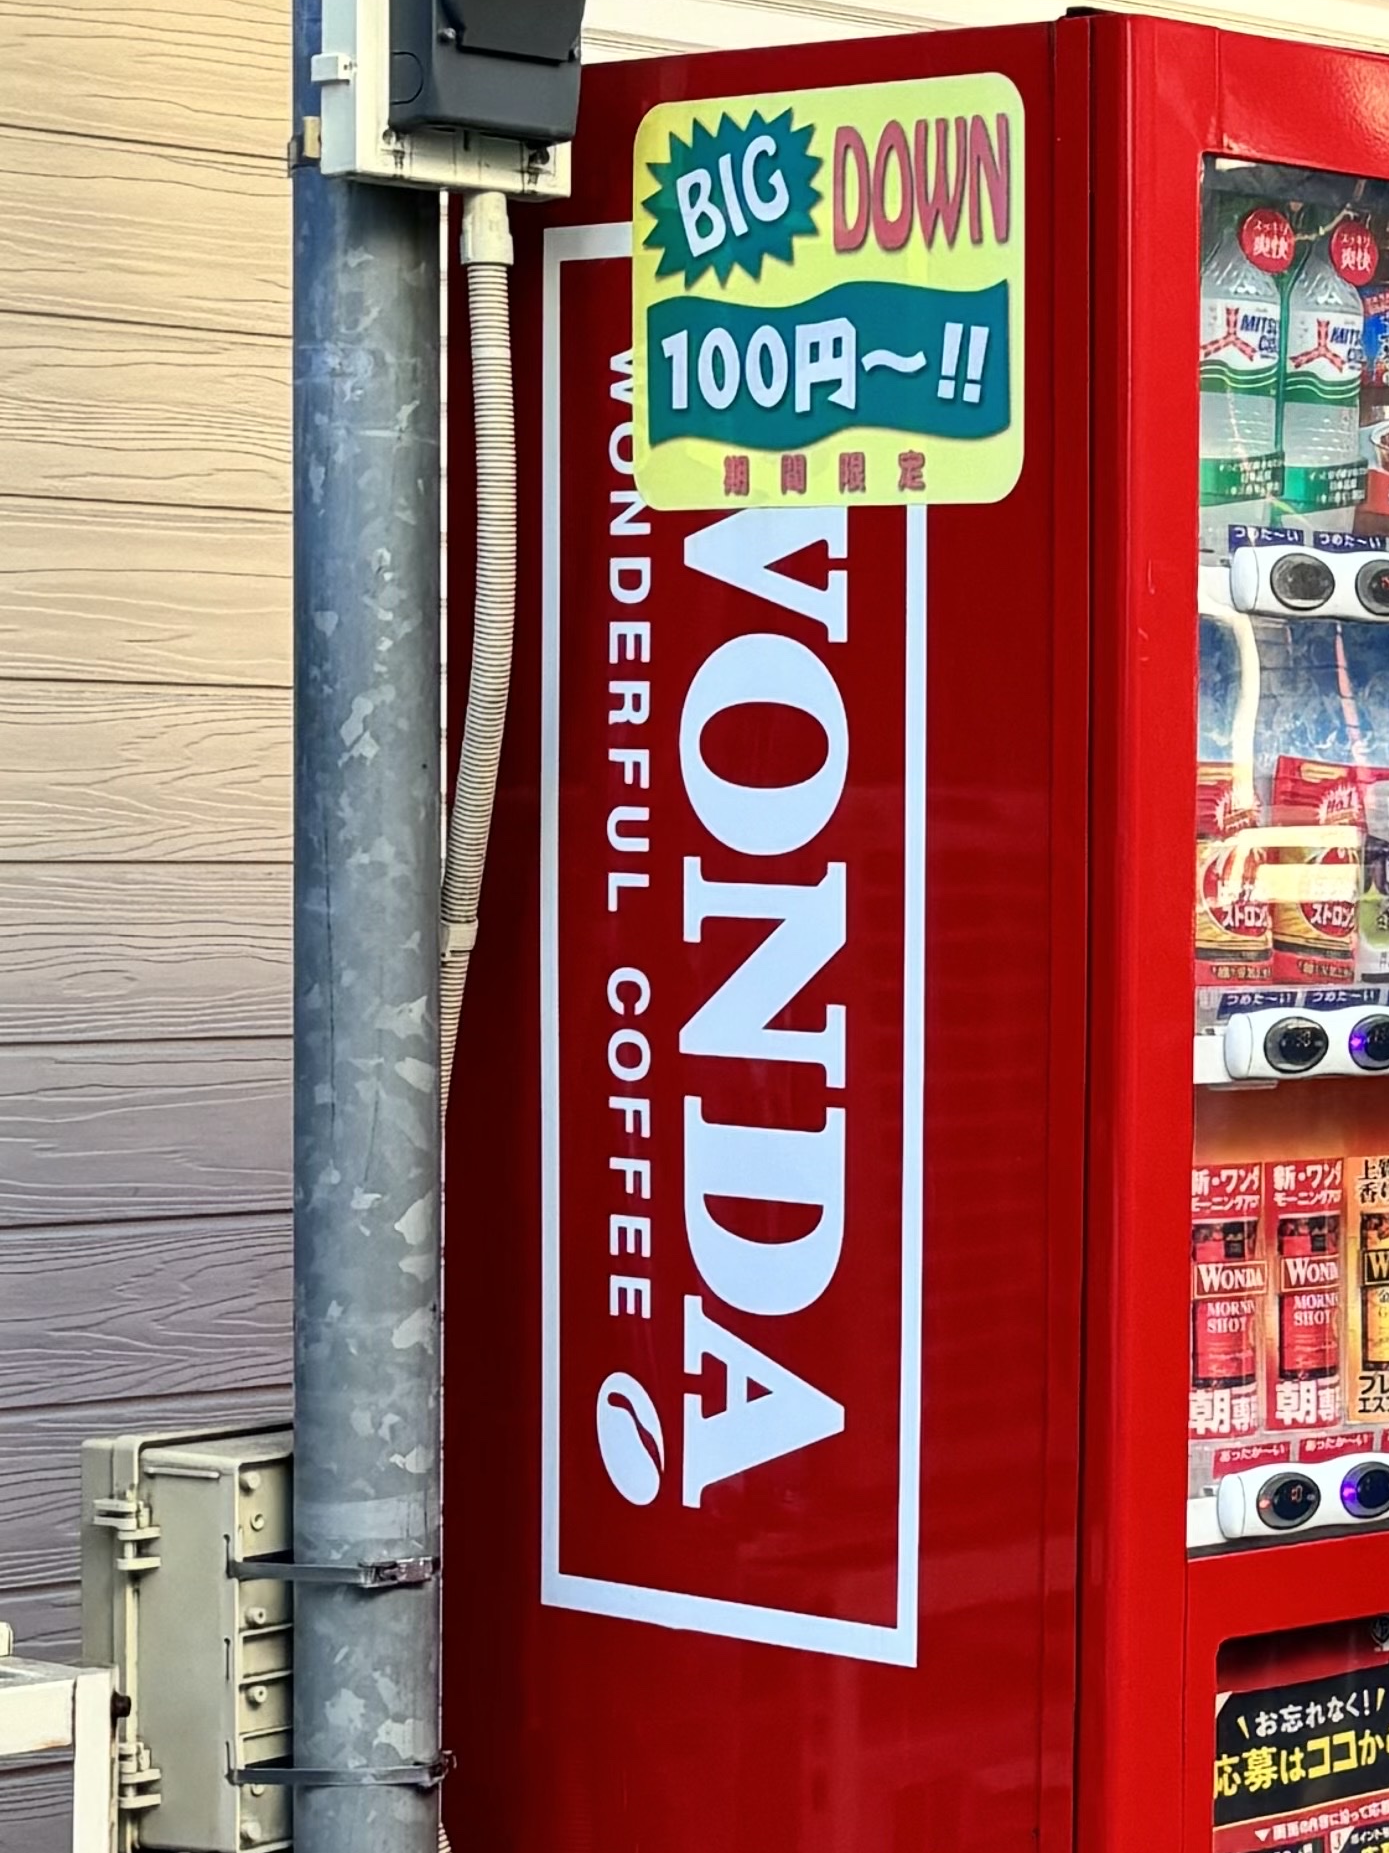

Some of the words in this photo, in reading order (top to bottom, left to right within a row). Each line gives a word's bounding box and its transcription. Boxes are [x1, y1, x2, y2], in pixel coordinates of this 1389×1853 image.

[676, 135, 790, 258] BIG
[832, 111, 1010, 253] DOWN
[1253, 236, 1289, 261] 爽快
[1340, 248, 1371, 272] 爽快
[723, 449, 928, 497] 期間限定
[607, 966, 652, 1319] COFFEE
[1199, 1261, 1265, 1293] WONDA
[1207, 1316, 1247, 1334] SHOT
[1294, 1310, 1331, 1328] SHOT
[1254, 1689, 1370, 1737] お忘れなく!
